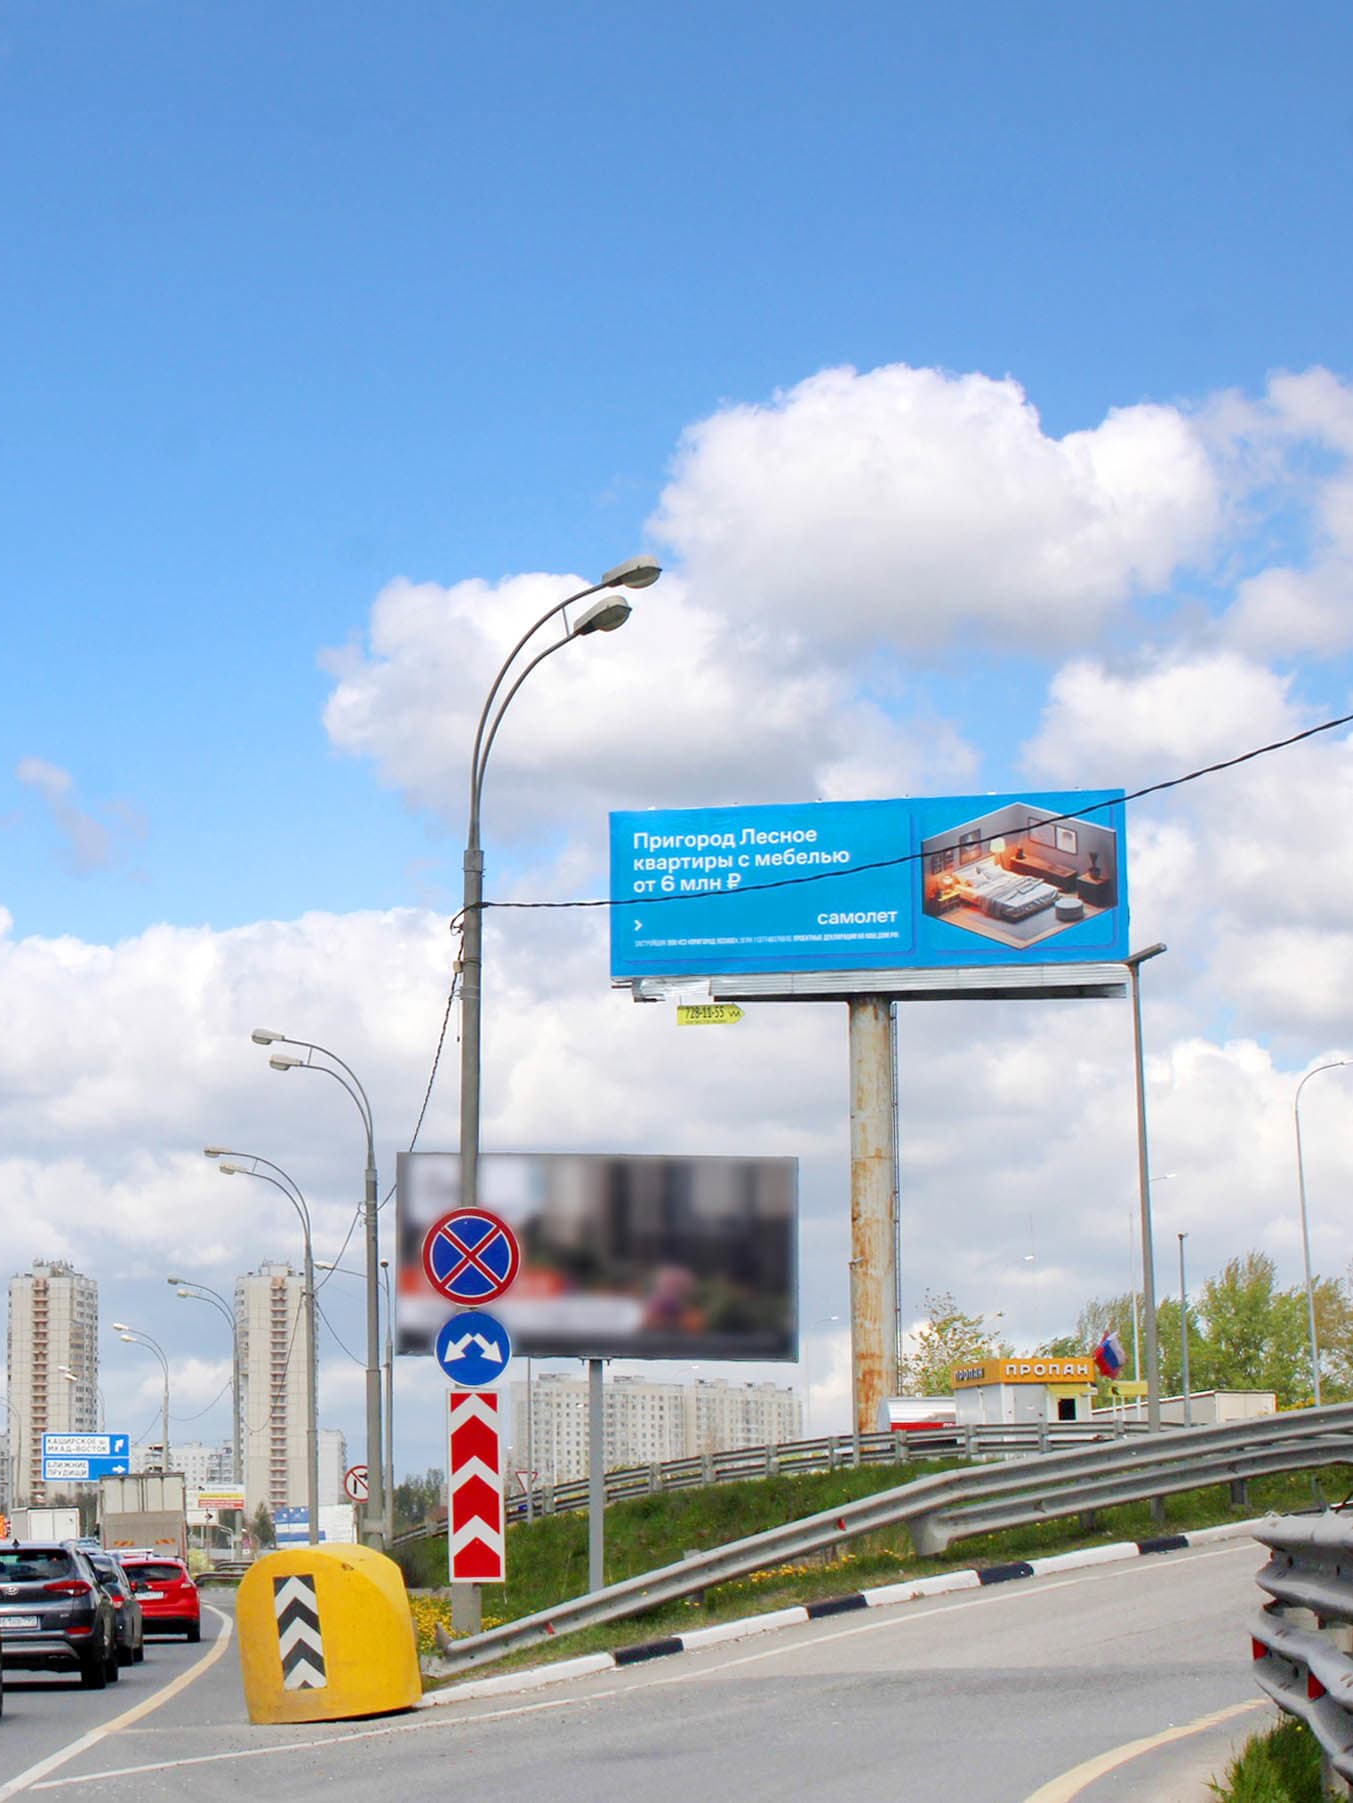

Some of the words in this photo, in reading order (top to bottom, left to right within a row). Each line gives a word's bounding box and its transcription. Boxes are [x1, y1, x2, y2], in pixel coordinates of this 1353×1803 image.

[633, 831, 736, 852] Пригород
[739, 828, 817, 845] Лесное
[633, 854, 733, 873] квартиры
[737, 853, 750, 867] с
[754, 848, 850, 867] мебелью
[633, 879, 656, 894] от
[660, 875, 675, 892] 6
[680, 876, 722, 891] млн
[817, 910, 898, 926] самолет
[1005, 1364, 1089, 1377] ПРОПАН
[48, 1469, 87, 1477] ПРУДИЩИ
